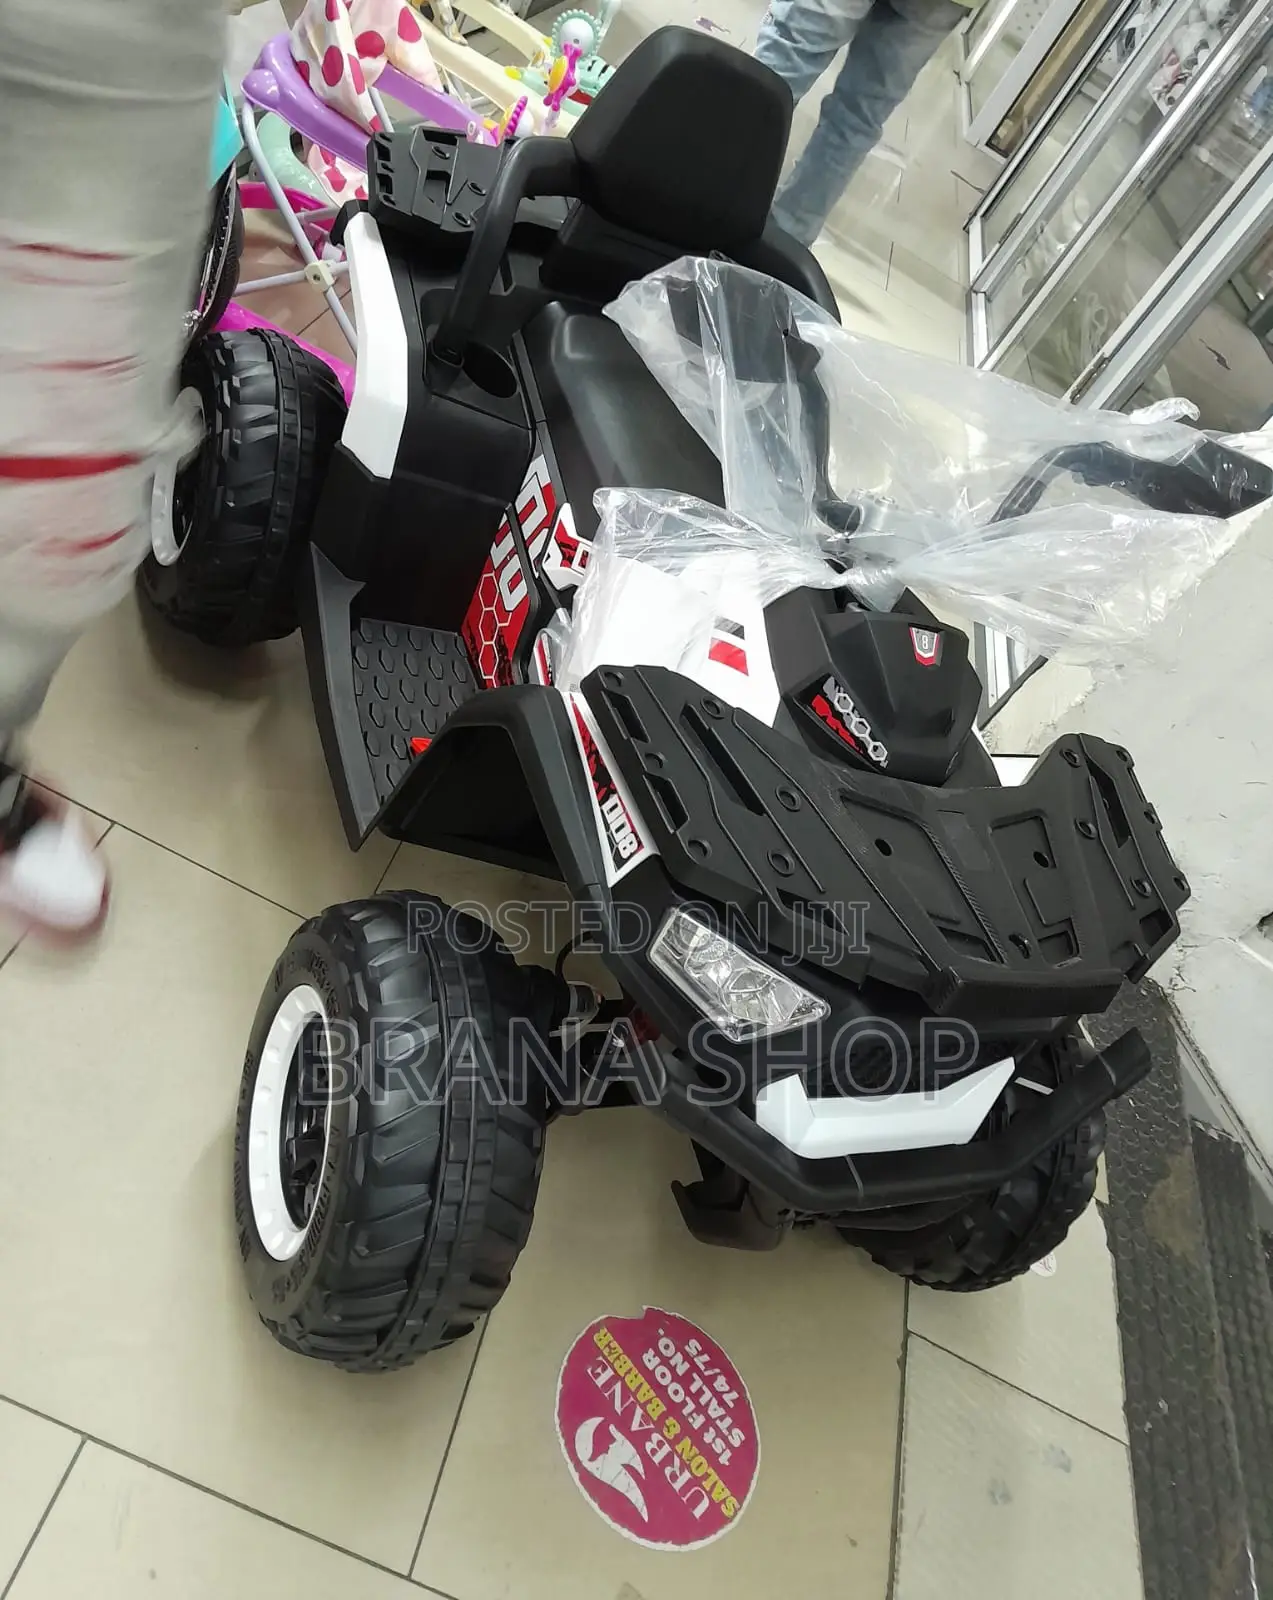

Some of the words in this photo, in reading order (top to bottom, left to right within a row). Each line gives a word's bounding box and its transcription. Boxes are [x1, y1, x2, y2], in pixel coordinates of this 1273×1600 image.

[593, 1326, 667, 1421] BARBER
[642, 1348, 706, 1430] FLOOR
[658, 1328, 691, 1376] NO.
[684, 1338, 740, 1408] 74/75
[587, 1356, 710, 1520] URBANE
[663, 1416, 681, 1439] &
[689, 1372, 746, 1448] STALL
[675, 1436, 740, 1519] SALON
